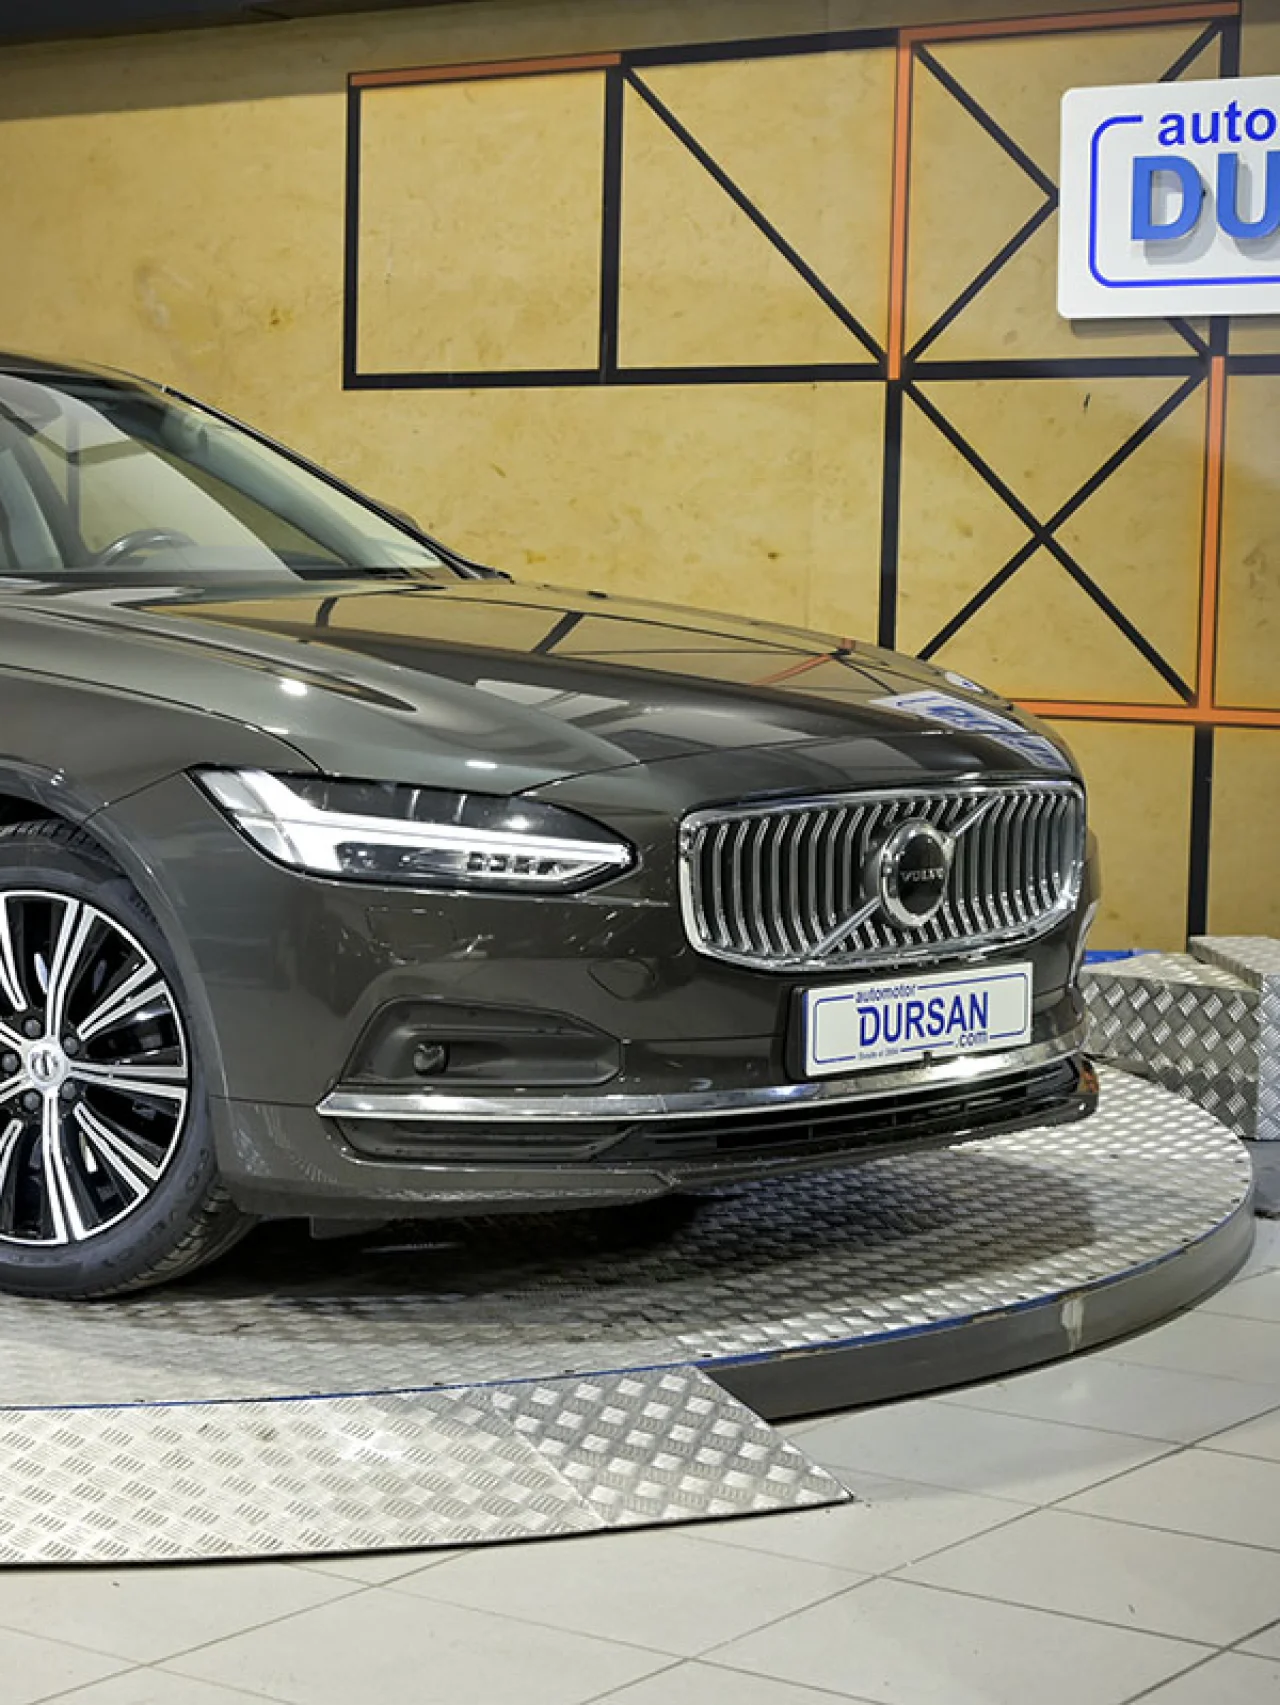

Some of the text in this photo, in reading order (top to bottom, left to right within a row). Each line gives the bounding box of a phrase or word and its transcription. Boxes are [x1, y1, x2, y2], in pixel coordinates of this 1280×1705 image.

[1157, 99, 1278, 146] auto
[1130, 150, 1280, 242] DU
[855, 984, 917, 1004] automotor
[857, 991, 989, 1047] DURSAN
